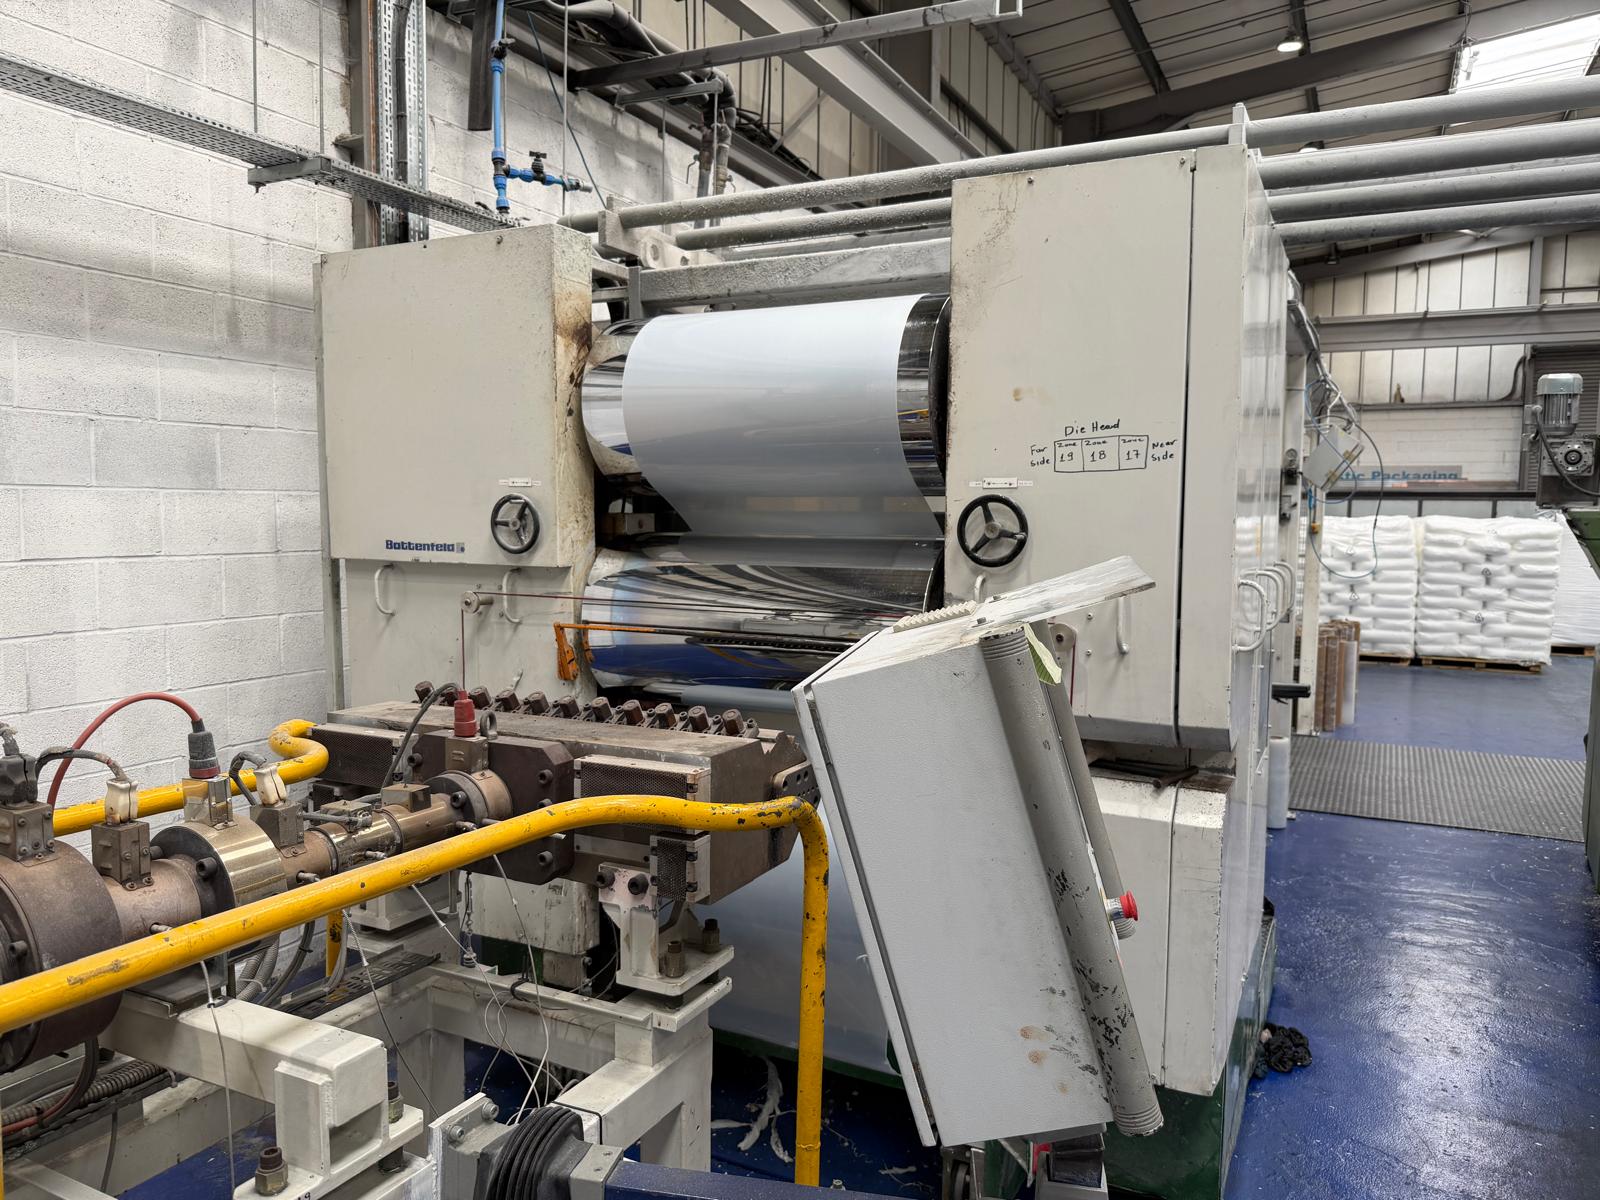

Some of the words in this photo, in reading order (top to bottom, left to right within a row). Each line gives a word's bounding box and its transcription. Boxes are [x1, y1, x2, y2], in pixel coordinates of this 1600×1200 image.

[1064, 426, 1087, 437] Die
[1091, 419, 1121, 433] Head
[1030, 444, 1048, 456] Far
[1151, 439, 1178, 449] Near
[1059, 451, 1074, 463] 19
[1089, 450, 1107, 462] 18
[1125, 449, 1141, 461] 17
[385, 540, 455, 552] Battenfeld
